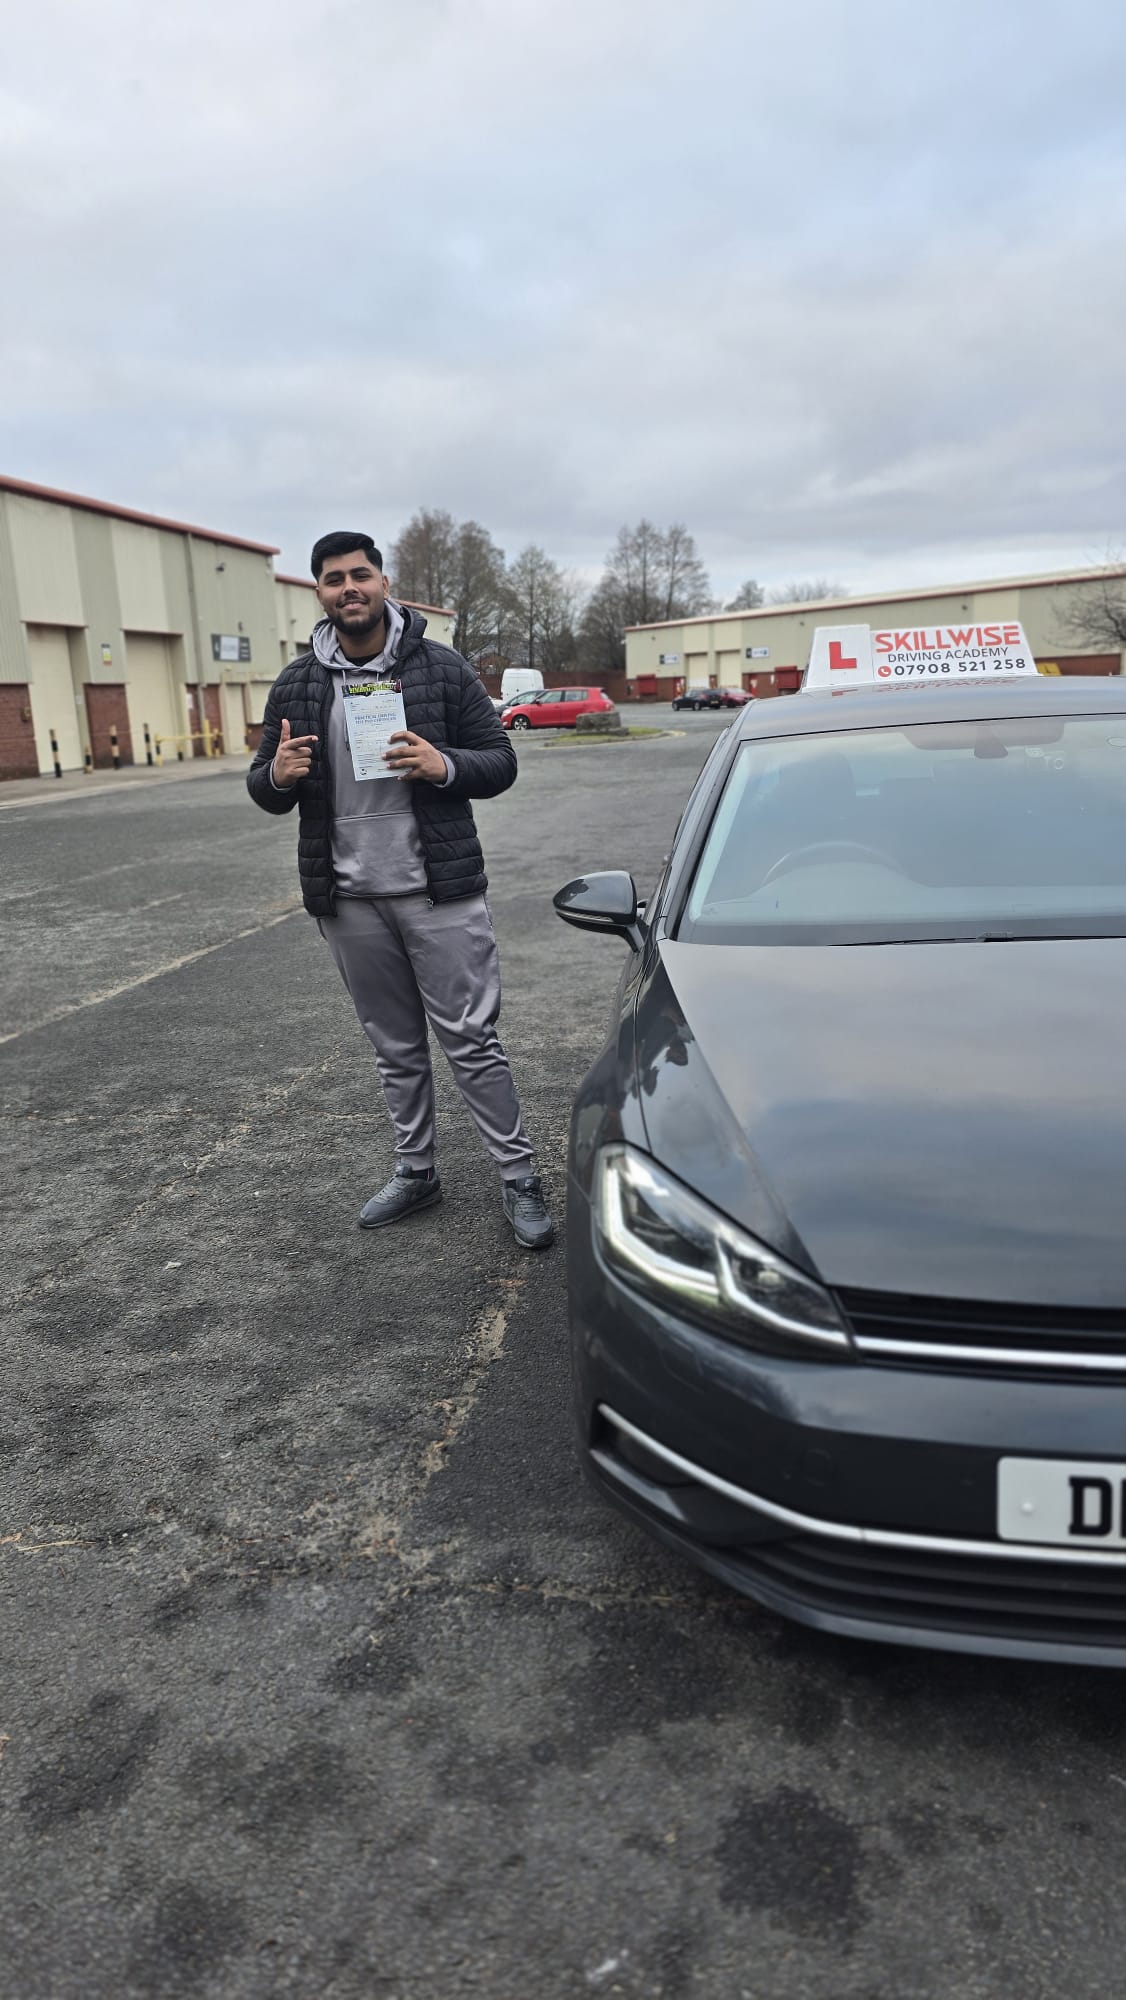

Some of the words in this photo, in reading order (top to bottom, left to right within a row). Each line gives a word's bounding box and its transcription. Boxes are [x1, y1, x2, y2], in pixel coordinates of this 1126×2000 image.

[875, 625, 1021, 653] SKILLWISE
[828, 641, 857, 670] L
[888, 651, 942, 663] DRIVING
[945, 646, 1009, 660] ACADEMY
[894, 663, 951, 676] 07908
[958, 660, 987, 673] 521
[993, 658, 1026, 671] 258
[1068, 1475, 1126, 1539] D
